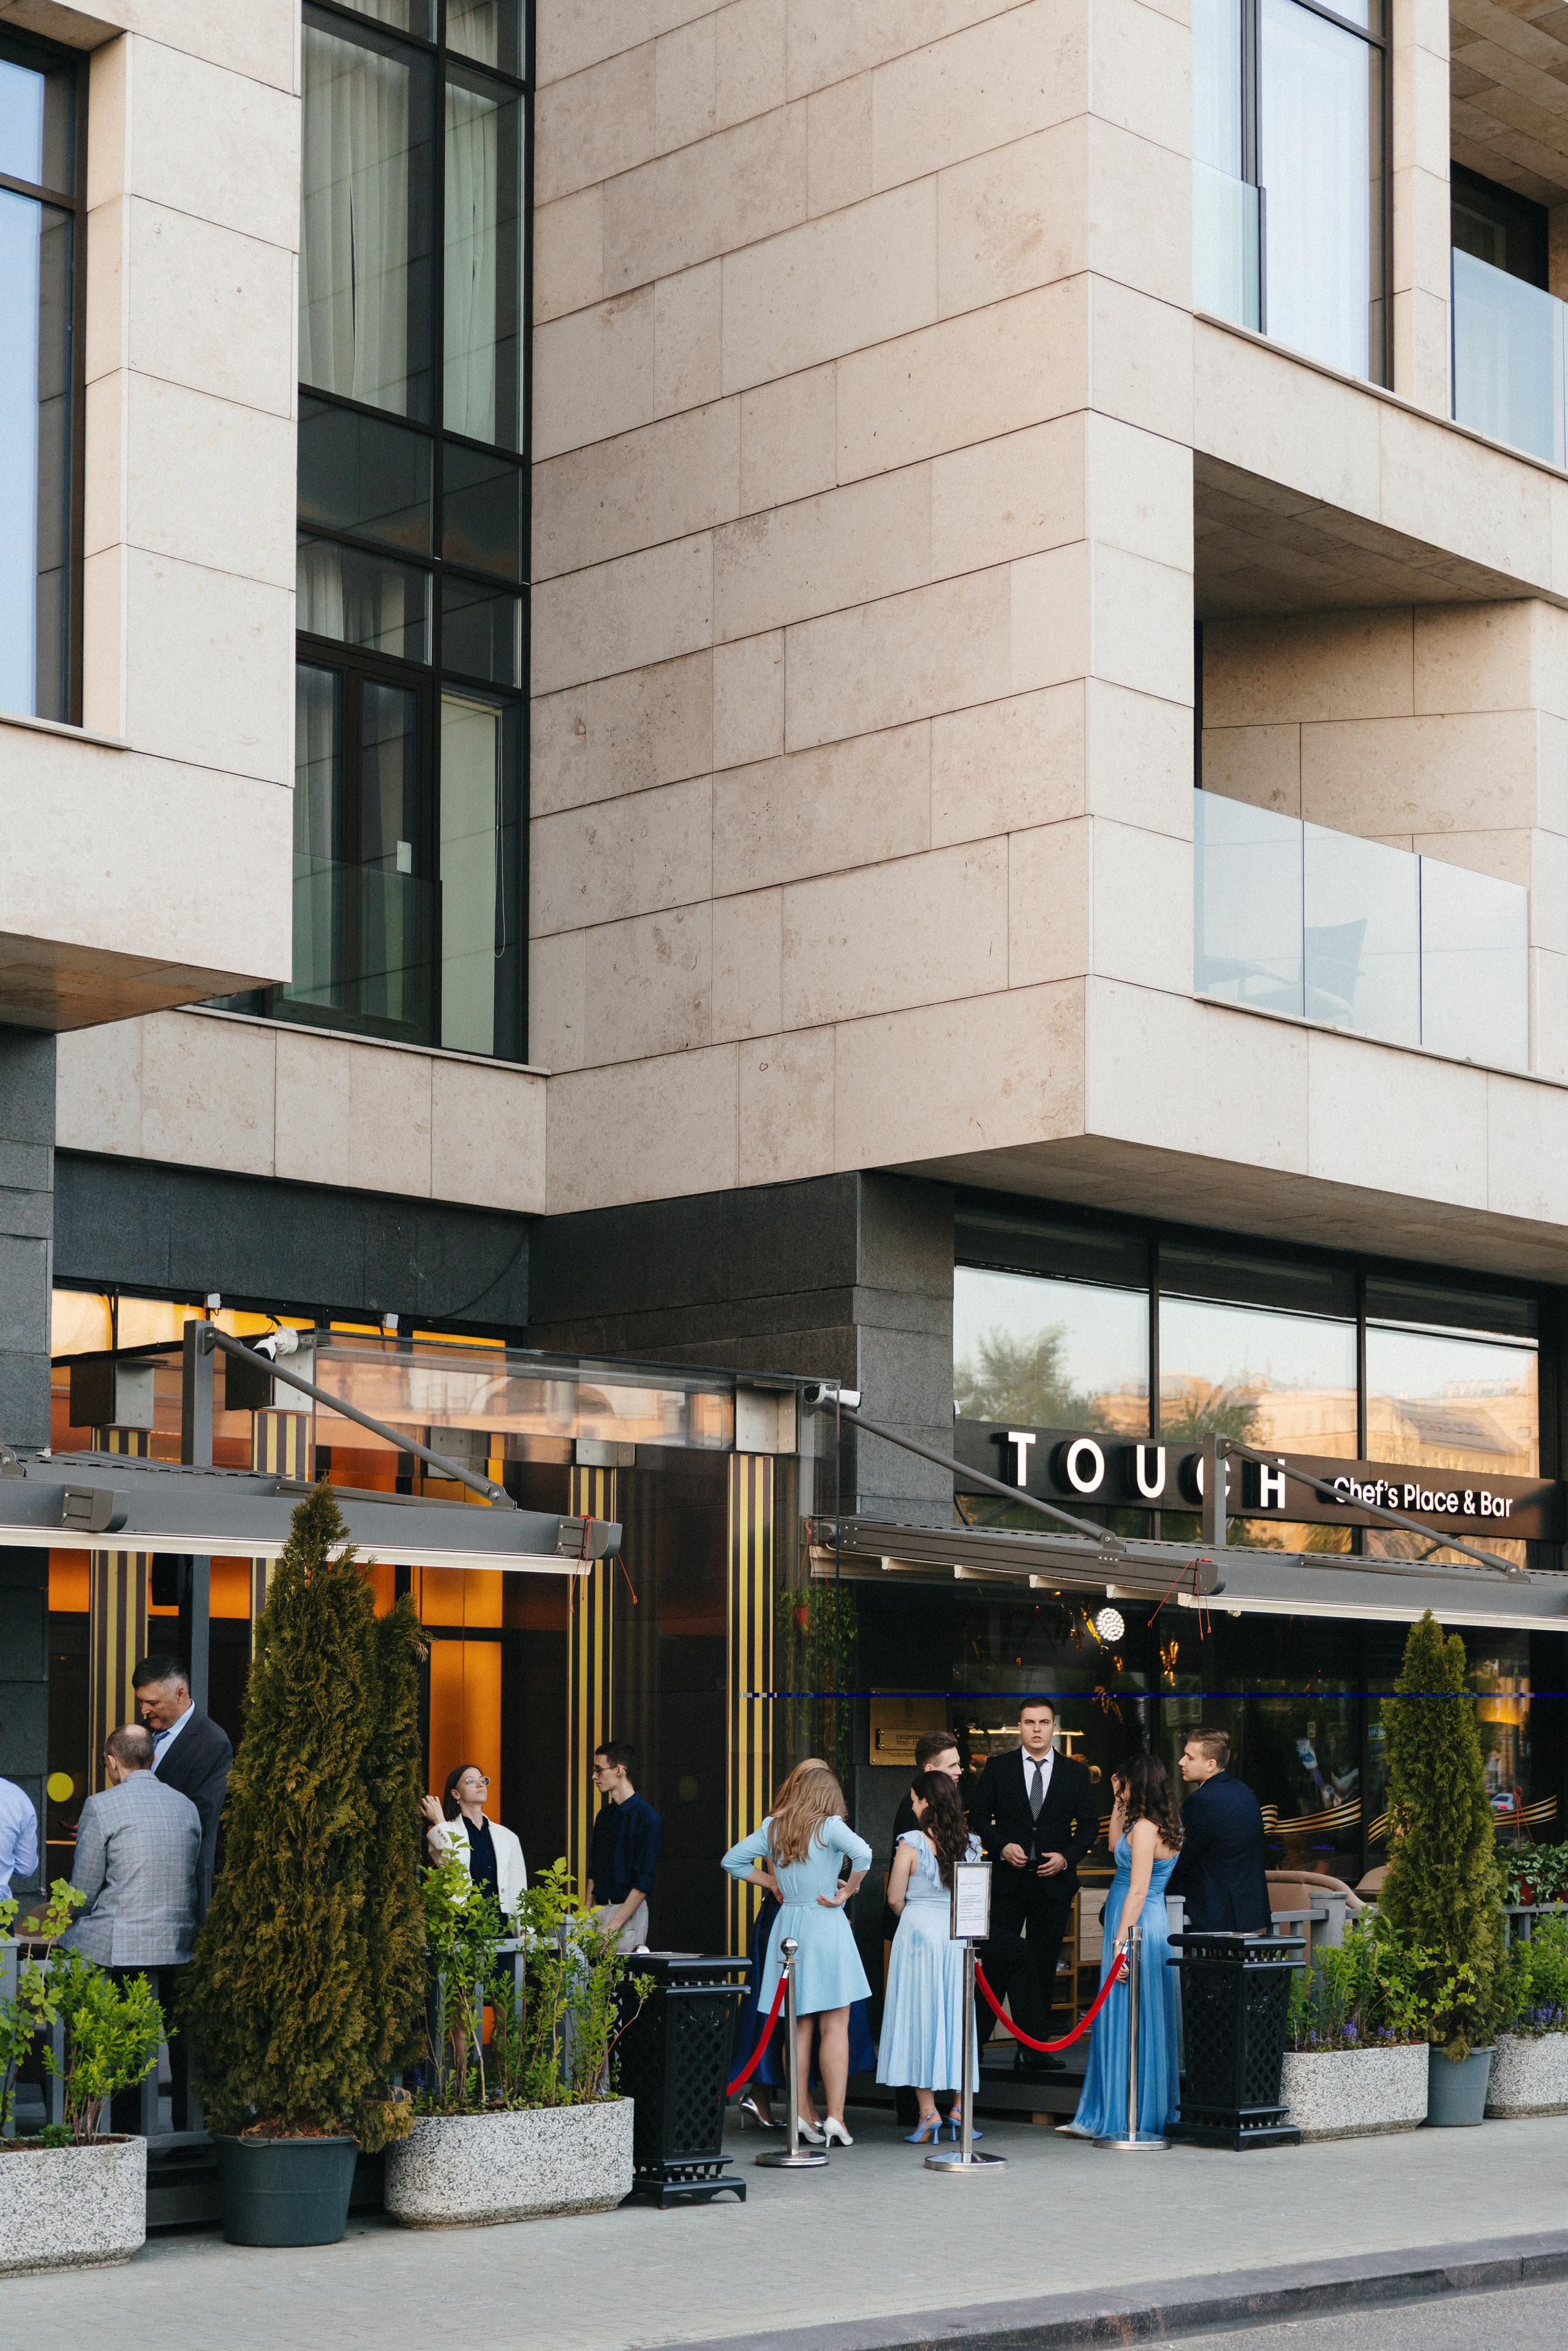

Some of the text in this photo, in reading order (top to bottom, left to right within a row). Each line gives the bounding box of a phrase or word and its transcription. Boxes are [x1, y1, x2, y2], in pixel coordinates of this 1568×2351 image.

[1333, 1476, 1513, 1518] Chef's Place & Bar
